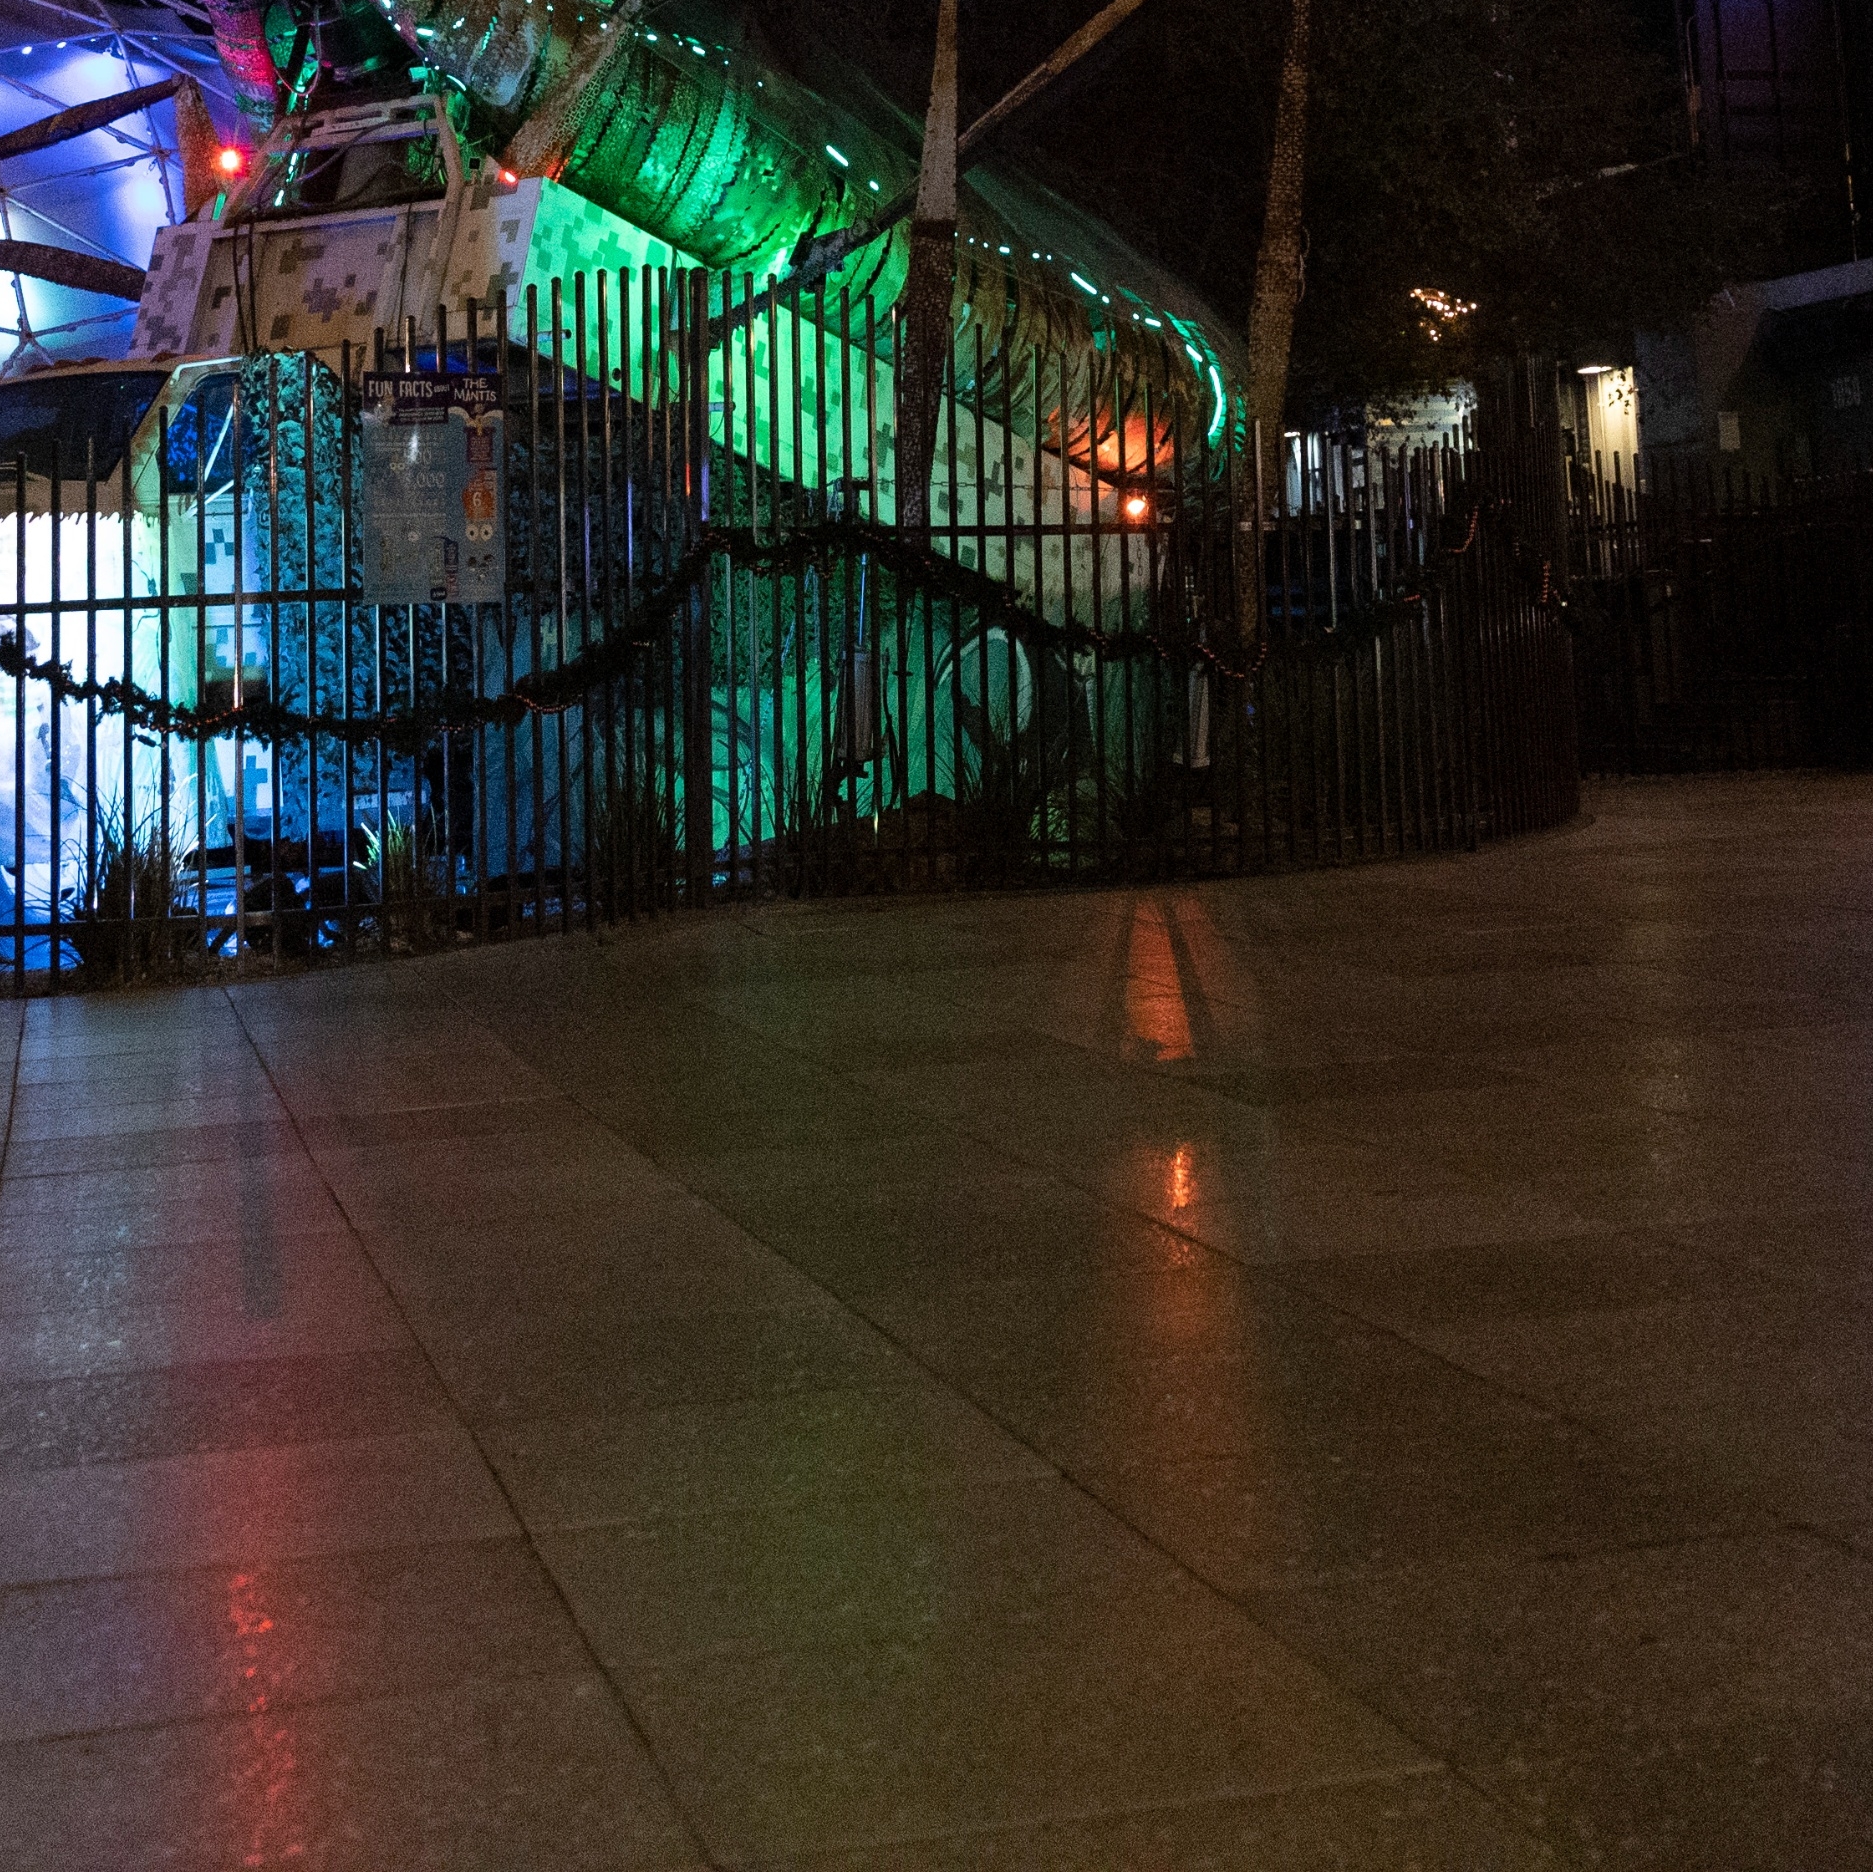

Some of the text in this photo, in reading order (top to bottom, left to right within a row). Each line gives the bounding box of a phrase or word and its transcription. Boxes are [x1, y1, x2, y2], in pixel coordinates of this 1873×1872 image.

[368, 380, 393, 397] FUN
[399, 380, 433, 398] FACTS
[462, 377, 488, 389] THE
[453, 388, 497, 402] MANTIS
